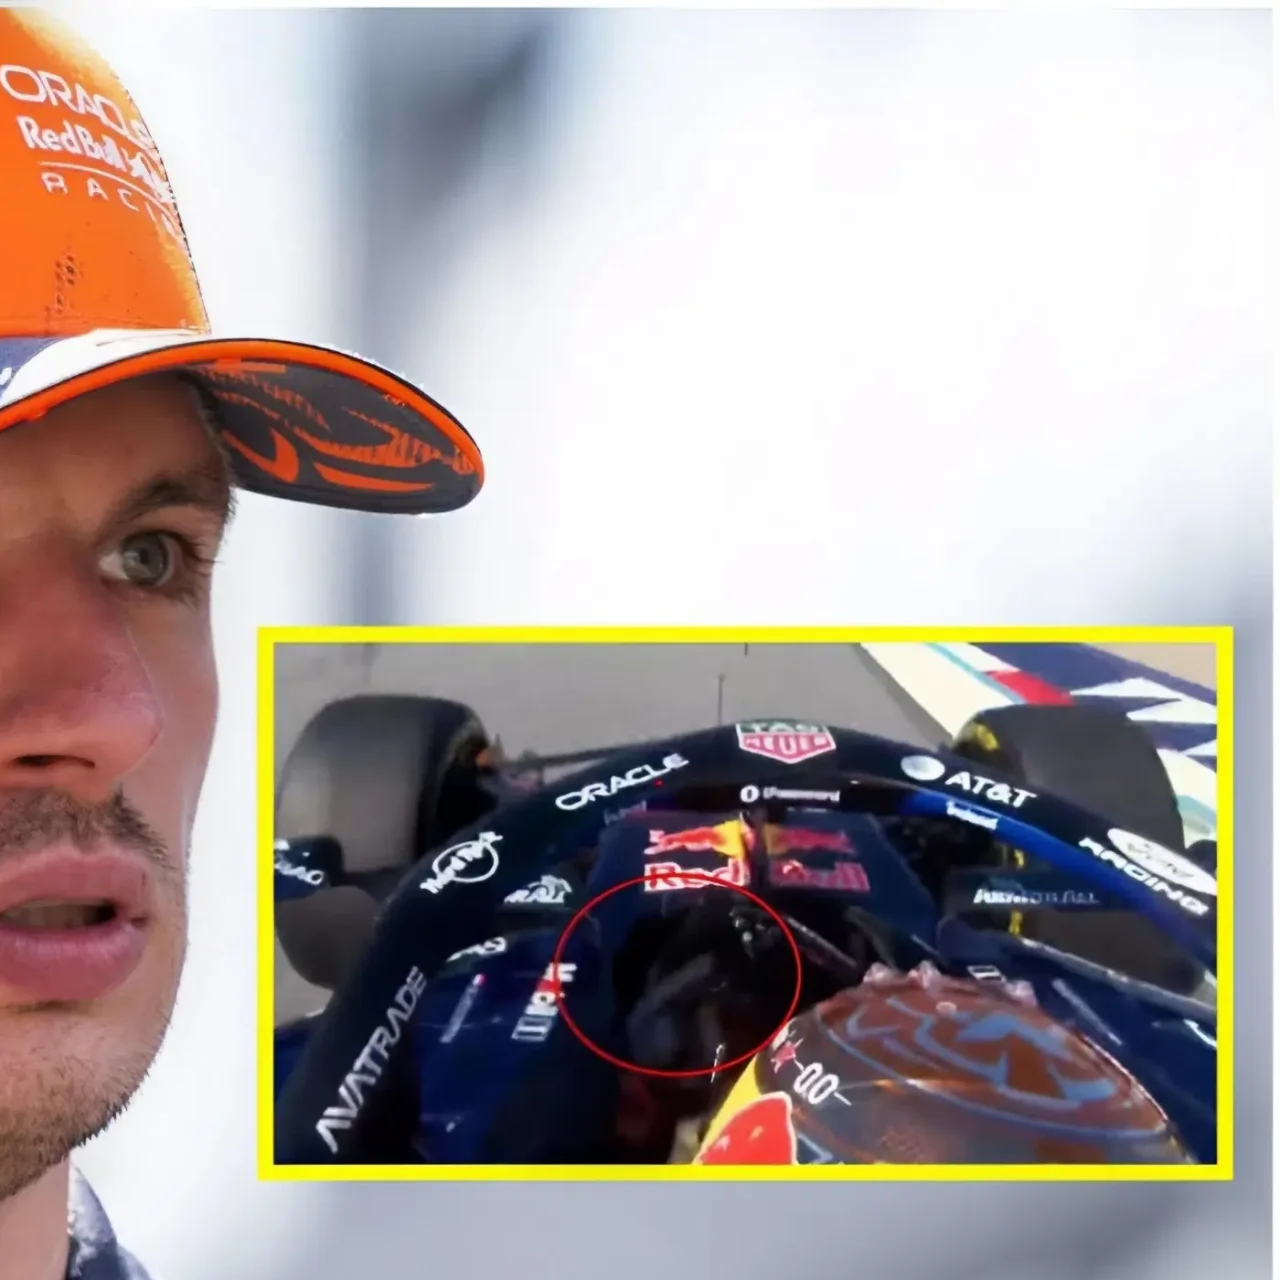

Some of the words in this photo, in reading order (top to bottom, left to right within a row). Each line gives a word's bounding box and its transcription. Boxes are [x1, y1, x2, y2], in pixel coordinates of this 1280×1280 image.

[556, 752, 690, 810] ORACLE
[944, 770, 1038, 809] AT&T
[315, 965, 428, 1154] AVATRADE
